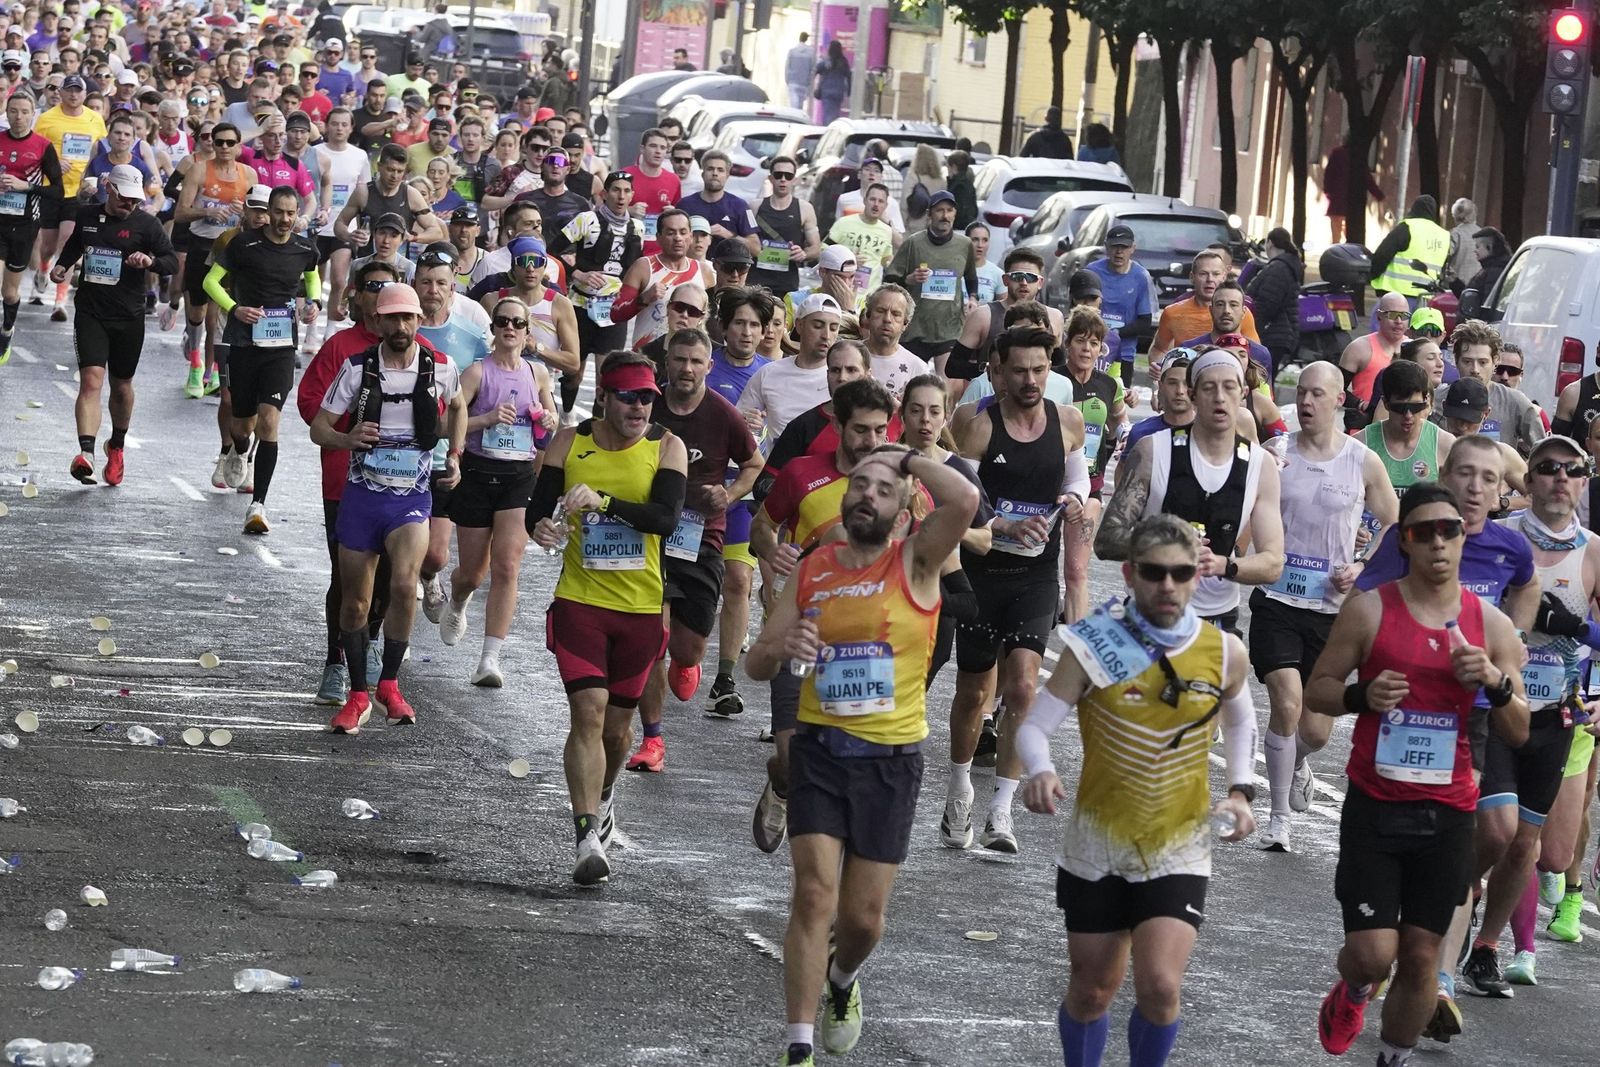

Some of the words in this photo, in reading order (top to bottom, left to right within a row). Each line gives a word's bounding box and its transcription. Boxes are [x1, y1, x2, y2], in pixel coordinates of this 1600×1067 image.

[263, 329, 282, 338] TONI
[498, 438, 517, 449] SIEL
[391, 467, 417, 477] RUNNER
[1016, 504, 1049, 515] ZURICH
[604, 532, 623, 541] 5851
[584, 543, 643, 556] CHAPOLIN
[1290, 557, 1323, 569] ZURICH
[1289, 572, 1307, 582] 5710
[1286, 583, 1306, 596] KIM
[1071, 617, 1127, 682] PEÑALOSA
[842, 668, 865, 679] 9519
[826, 683, 862, 698] JUAN
[867, 682, 884, 696] PE
[1409, 714, 1453, 727] ZURICH
[1408, 735, 1432, 747] 8873
[1399, 750, 1435, 766] JEFF
